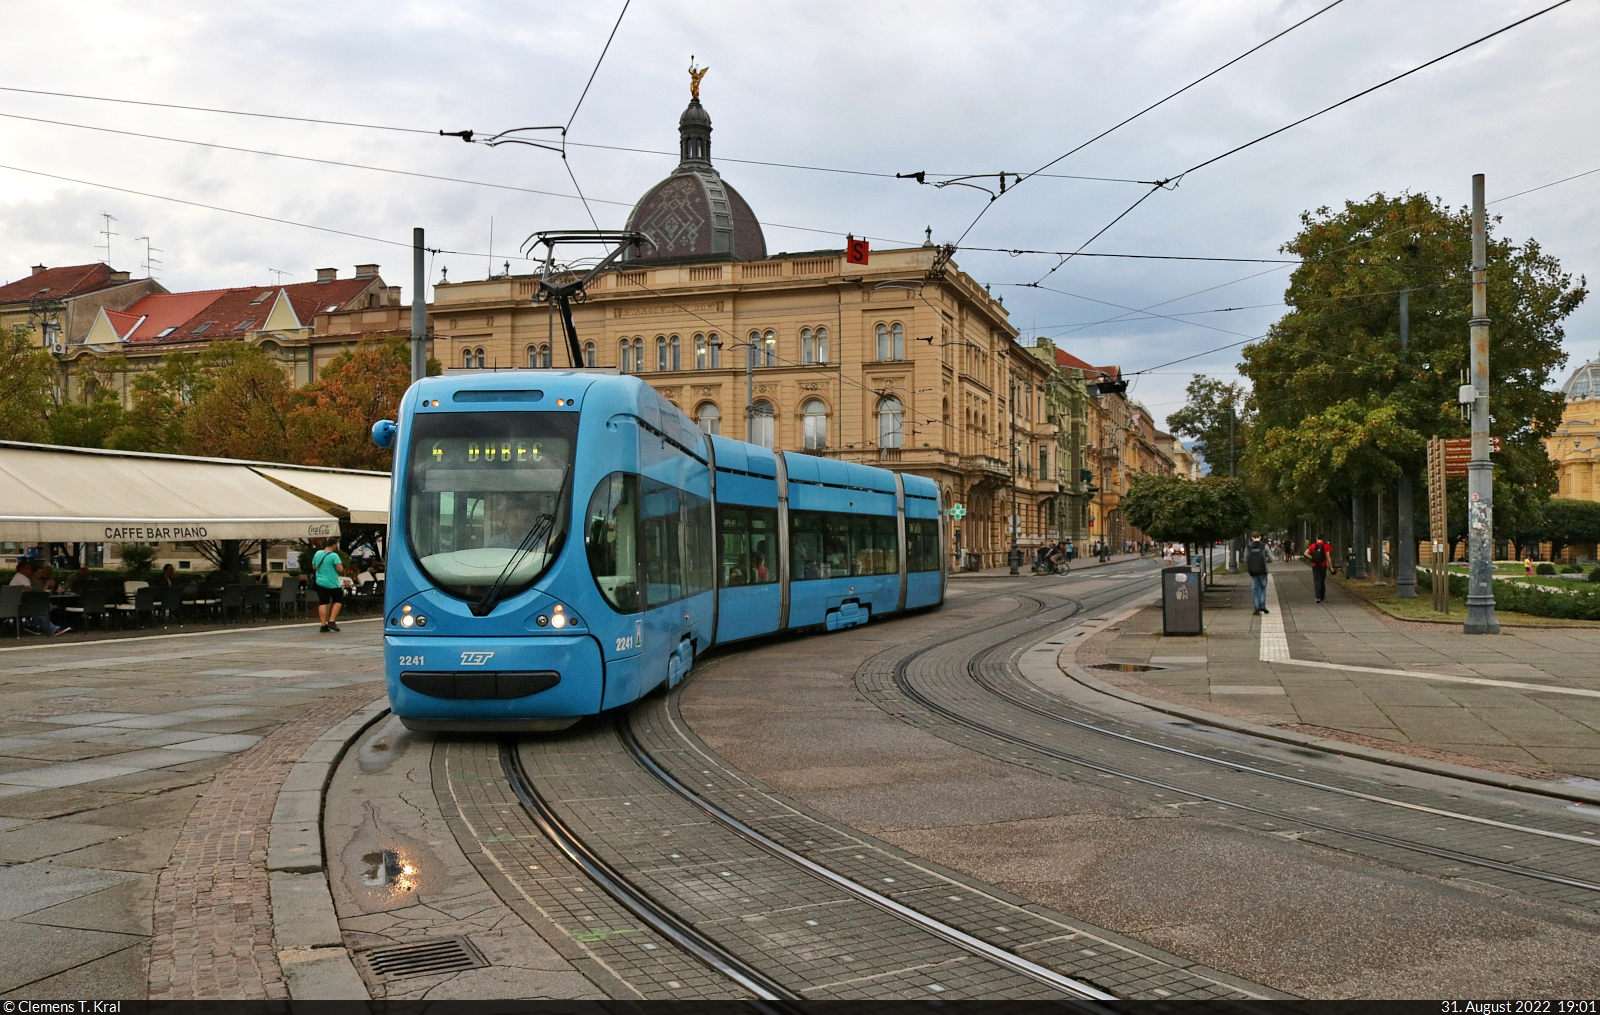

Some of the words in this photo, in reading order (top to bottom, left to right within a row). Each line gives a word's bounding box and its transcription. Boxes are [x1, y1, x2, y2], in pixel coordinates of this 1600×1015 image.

[853, 242, 864, 262] S
[432, 441, 443, 462] 4
[468, 441, 543, 462] DUBEC
[104, 527, 144, 539] CAFFE
[146, 527, 171, 539] BAR
[173, 526, 208, 538] PIANO
[615, 635, 633, 652] 2241
[399, 655, 424, 666] 2241
[460, 651, 495, 666] ZET
